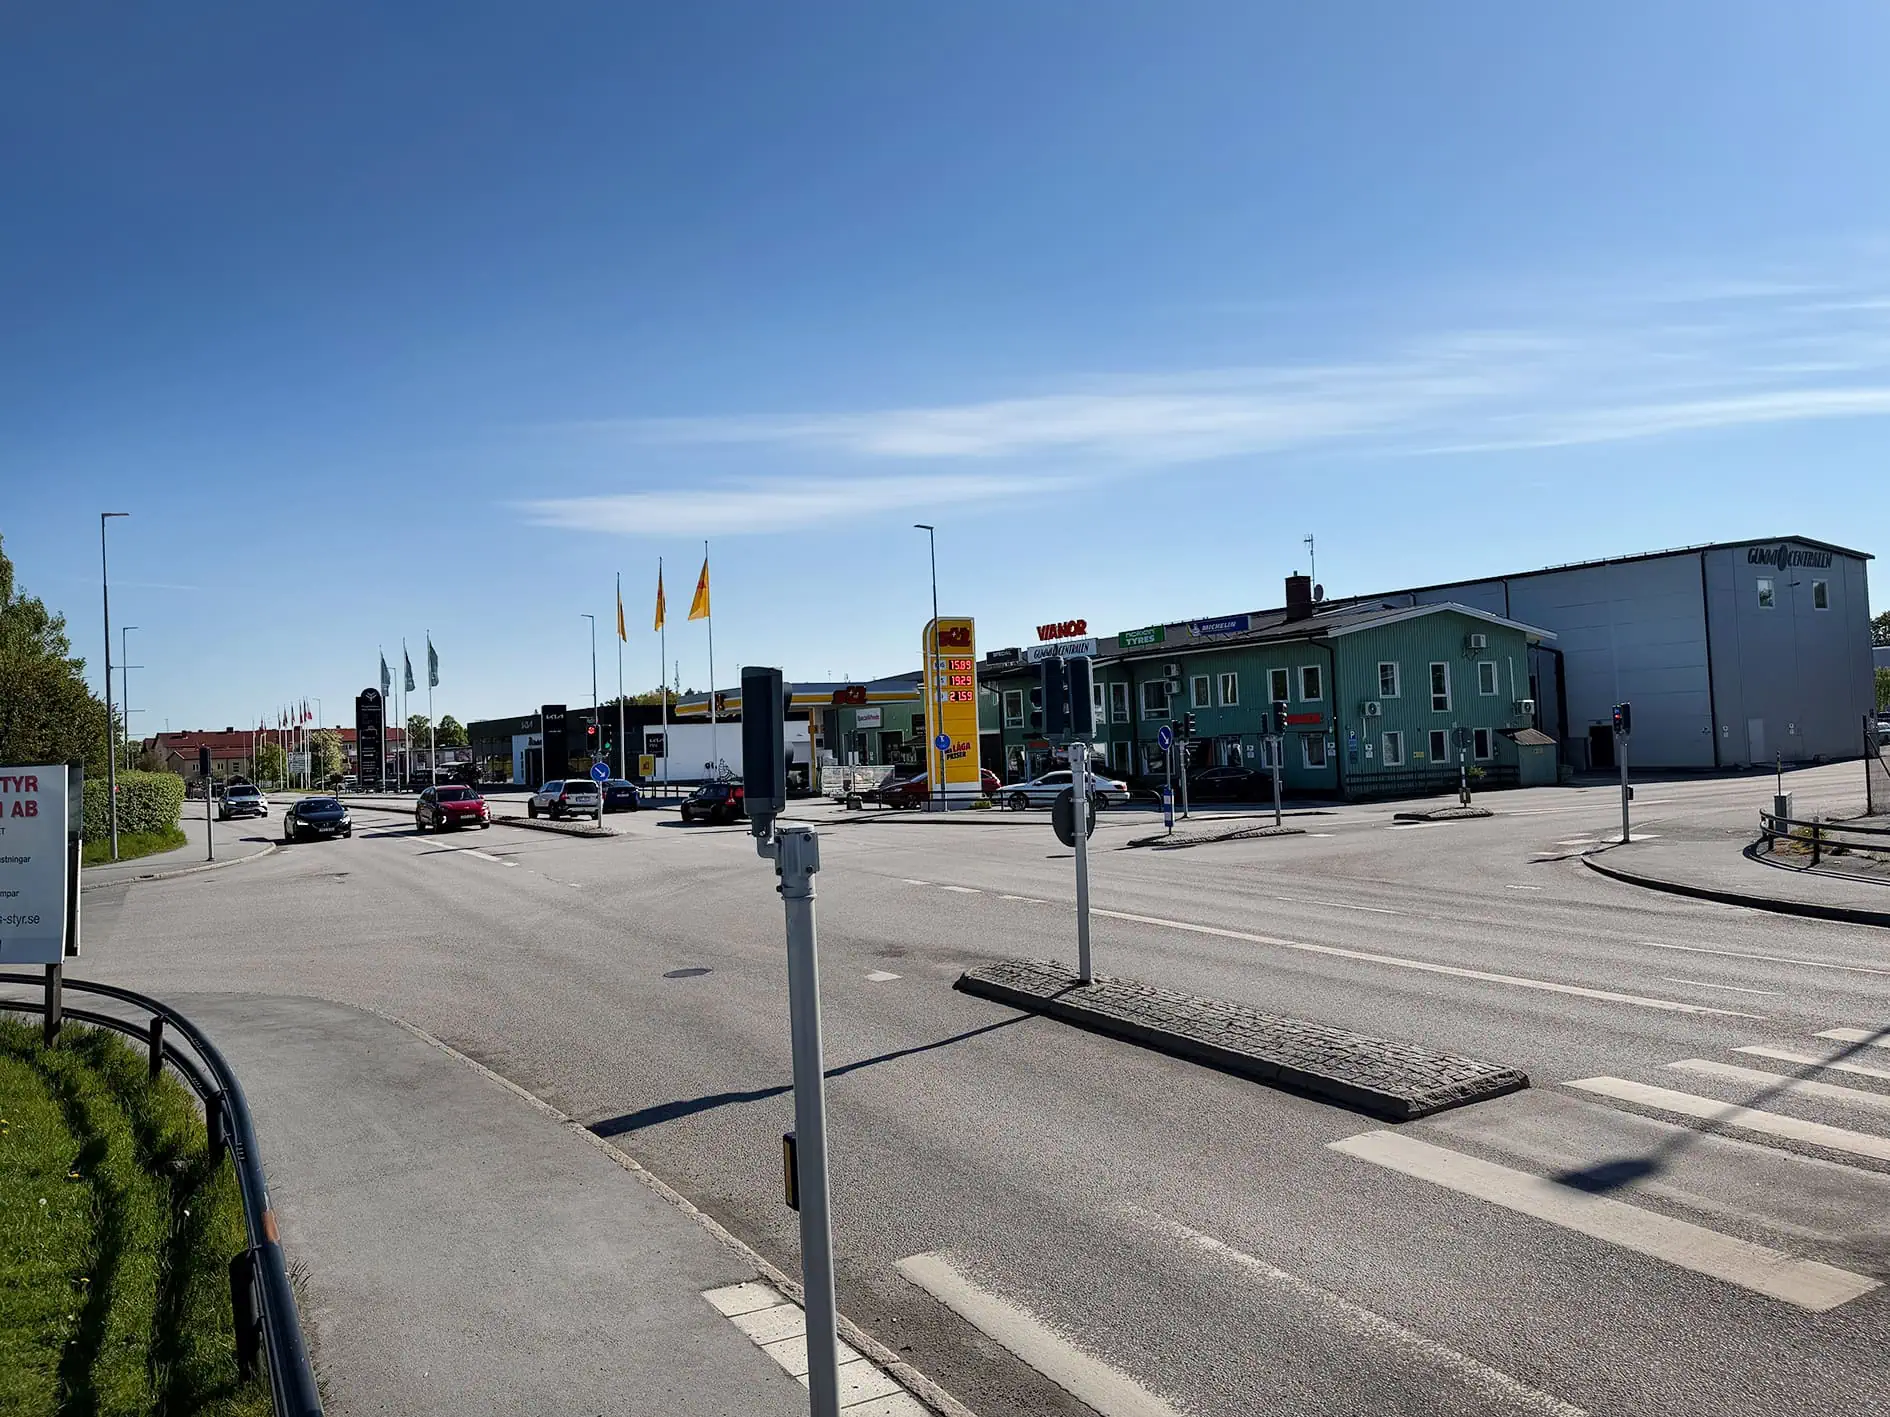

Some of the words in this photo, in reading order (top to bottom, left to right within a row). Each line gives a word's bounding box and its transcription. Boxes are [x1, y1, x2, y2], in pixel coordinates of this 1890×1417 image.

[1036, 619, 1088, 641] VIANOR
[1201, 621, 1237, 631] MICHELIN
[1126, 635, 1155, 646] TYRES
[953, 741, 971, 752] LÅGA
[11, 800, 38, 818] AB
[0, 856, 31, 864] stningar
